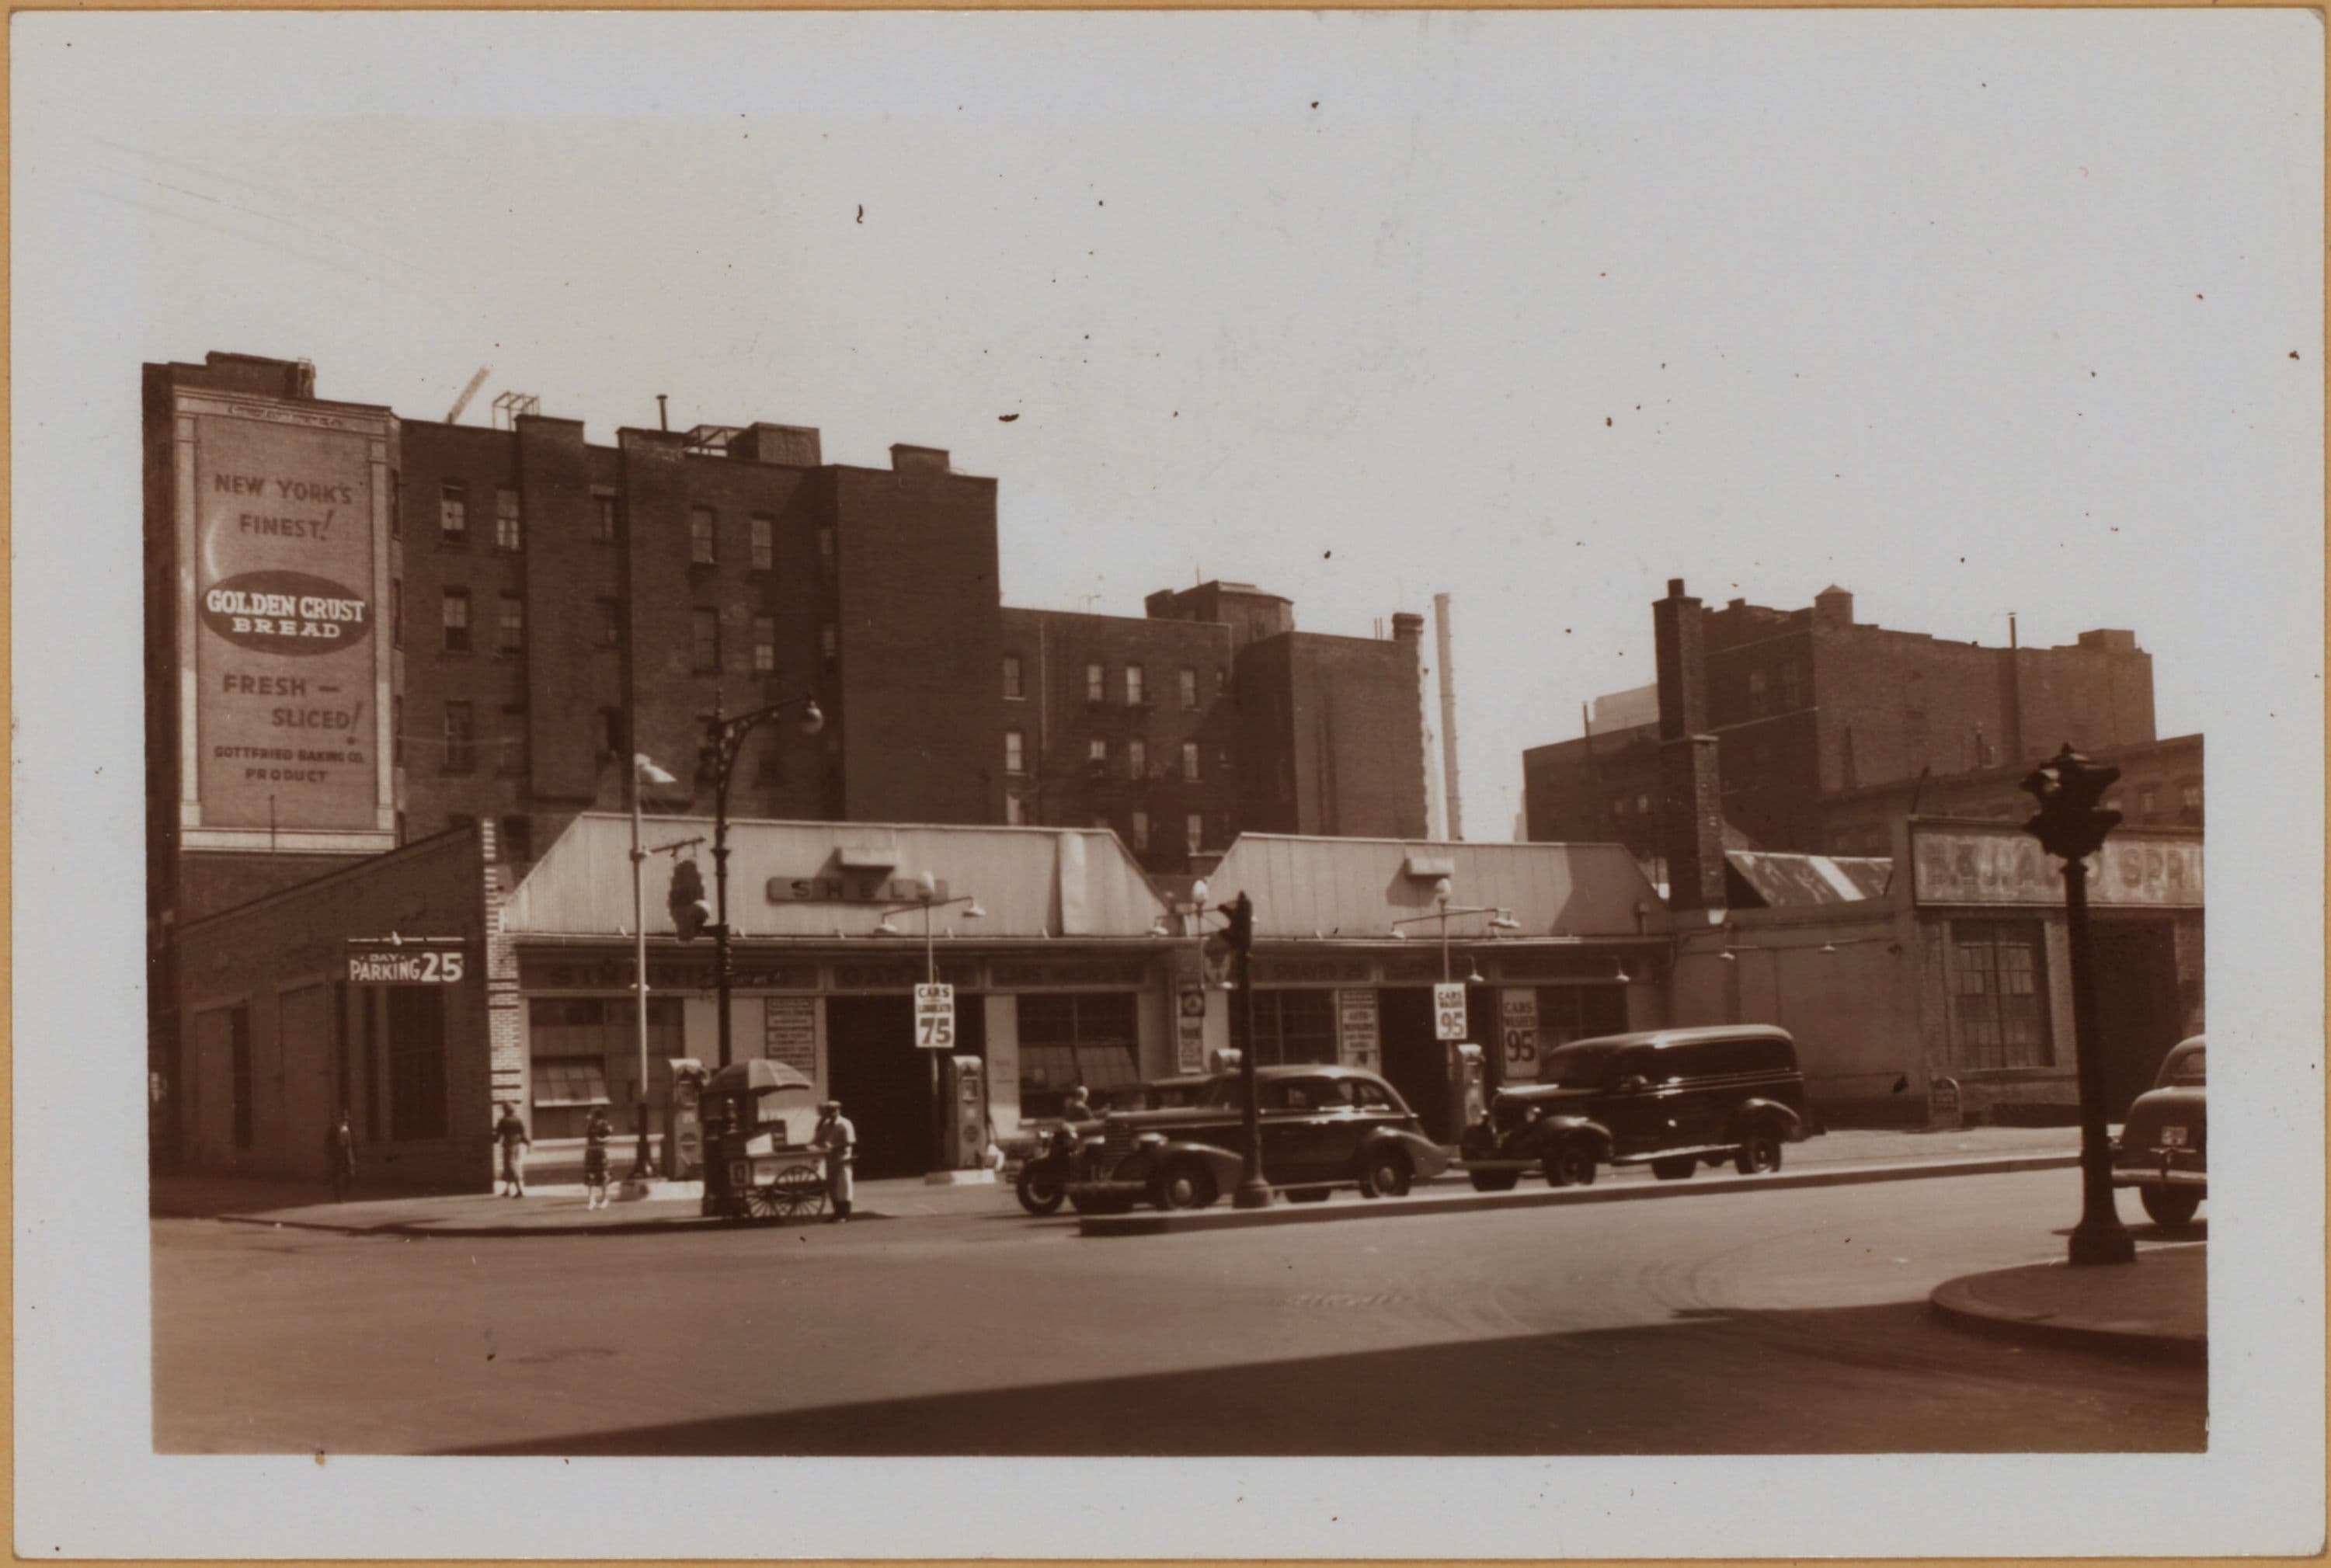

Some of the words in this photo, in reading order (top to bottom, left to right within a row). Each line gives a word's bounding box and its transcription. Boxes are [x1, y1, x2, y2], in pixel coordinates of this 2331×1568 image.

[214, 473, 265, 497] NEW
[277, 479, 353, 505] YORK'S
[239, 509, 334, 541] FINEST!
[206, 589, 297, 618] GOLDEN
[298, 596, 365, 623] CRUST
[231, 617, 342, 639] BREAD
[222, 674, 306, 697] FRESH
[271, 701, 363, 747] SLICED!
[214, 745, 293, 761] GOTTFRIED
[297, 749, 344, 763] BAKING
[244, 767, 329, 784] PRODUCT
[2119, 847, 2204, 888] SPRI
[349, 958, 420, 982] PARKING
[369, 953, 398, 963] DAY
[917, 986, 950, 998] CARS
[1437, 991, 1462, 1000] CARS
[1504, 1002, 1533, 1013] CARS
[920, 1017, 952, 1045] 75
[1440, 1011, 1463, 1036] 95
[1507, 1030, 1536, 1062] 95
